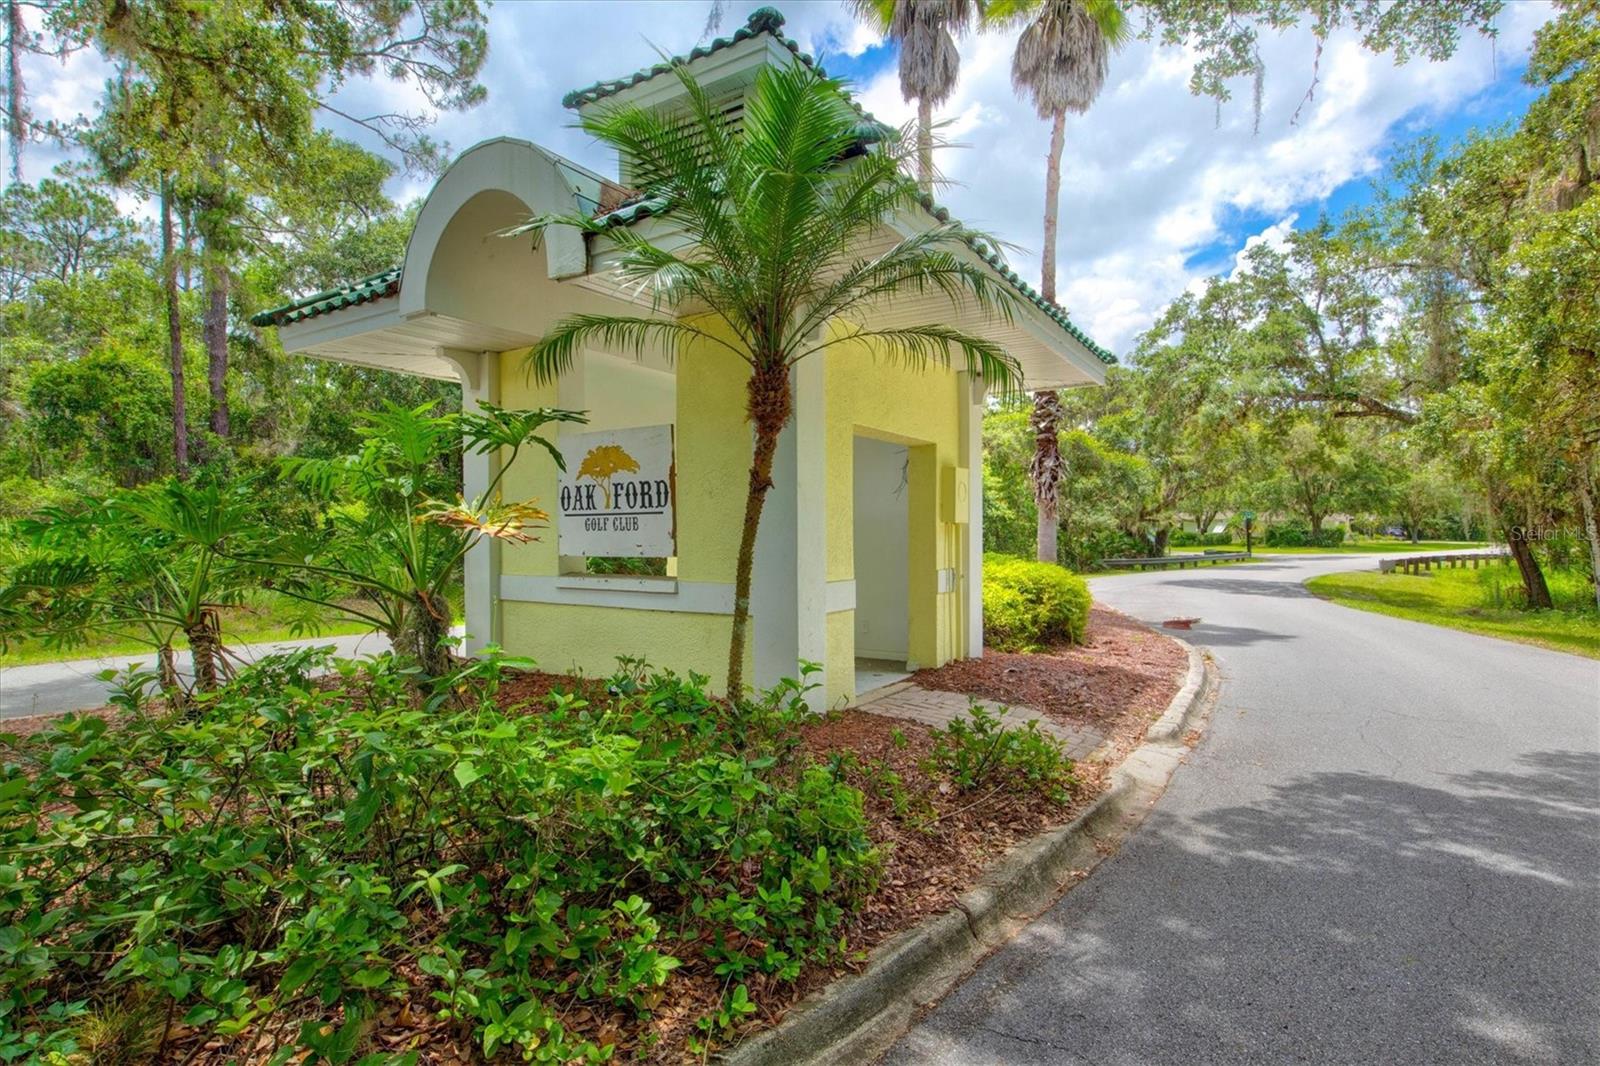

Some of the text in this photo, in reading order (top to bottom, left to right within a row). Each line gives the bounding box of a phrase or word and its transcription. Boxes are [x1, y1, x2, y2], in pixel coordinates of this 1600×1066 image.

[560, 480, 669, 511] OAK FORD
[584, 516, 639, 532] GOLF CLUB
